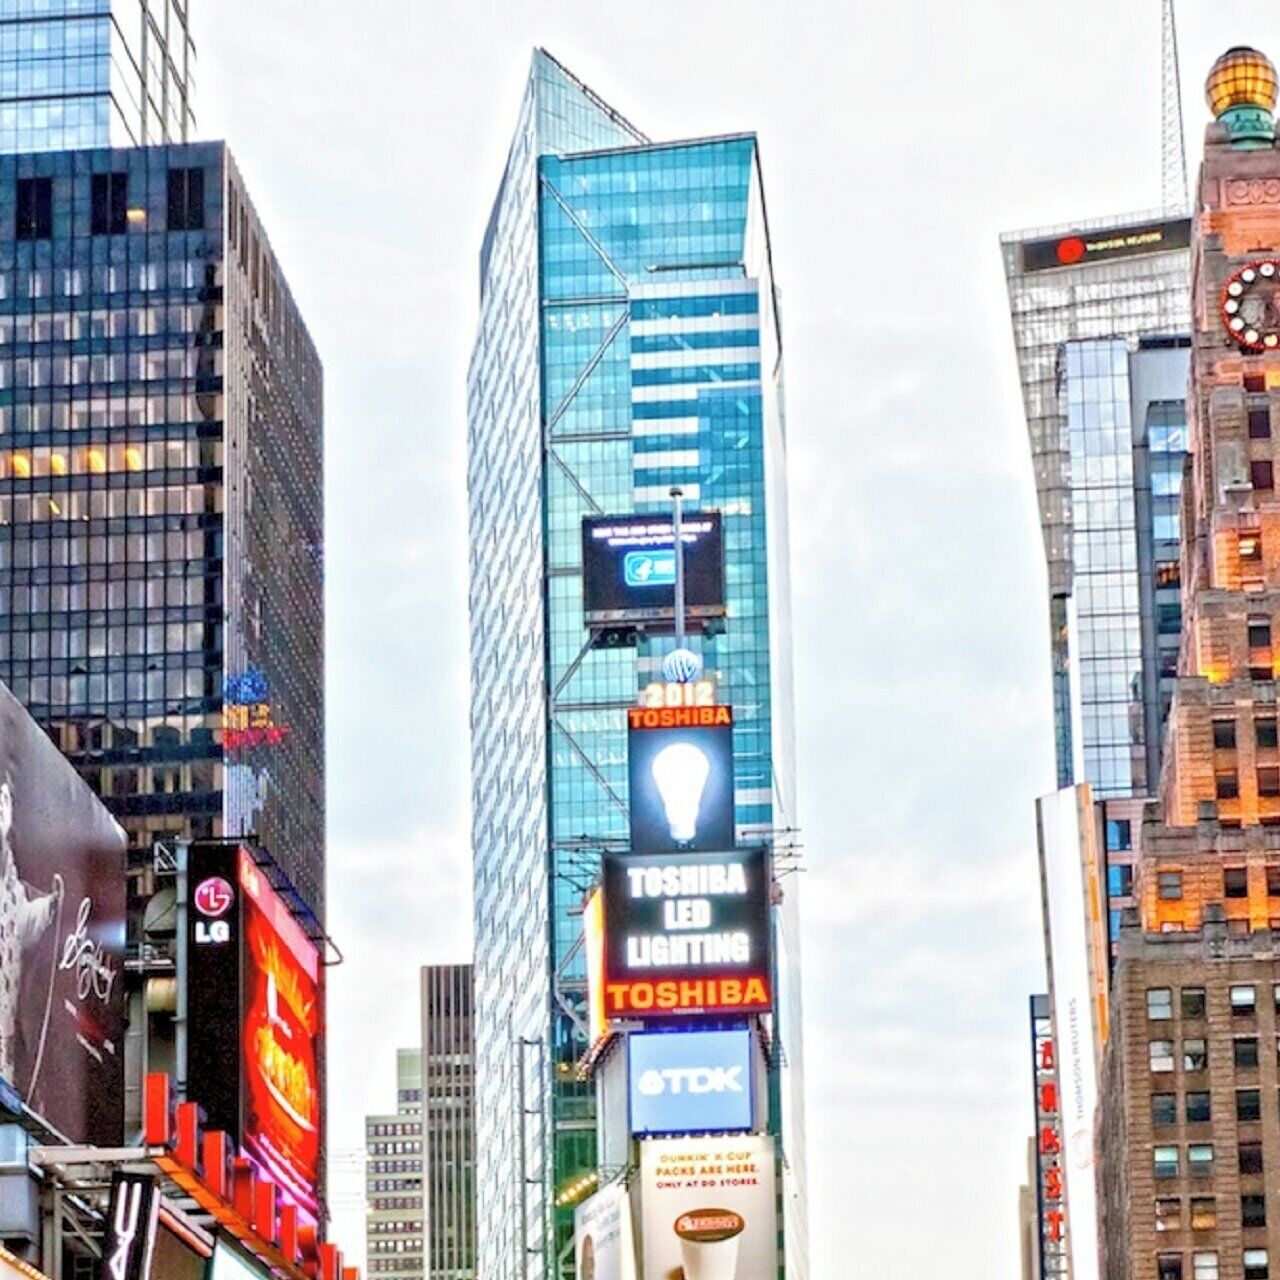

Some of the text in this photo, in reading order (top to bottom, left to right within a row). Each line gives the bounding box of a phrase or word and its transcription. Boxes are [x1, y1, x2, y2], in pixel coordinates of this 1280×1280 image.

[646, 682, 714, 706] 2012
[629, 708, 730, 728] TOSHIBA
[628, 866, 747, 898] TOSHIBA
[664, 900, 711, 930] LED
[195, 921, 231, 944] LG
[627, 932, 749, 967] LIGHTING
[608, 977, 768, 1011] TOSHIBA
[661, 1067, 745, 1095] TDK
[655, 1163, 760, 1178] PACKS ARE HERE.
[656, 1178, 683, 1190] ONLY
[685, 1178, 699, 1189] AT
[720, 1177, 761, 1188] STORES.
